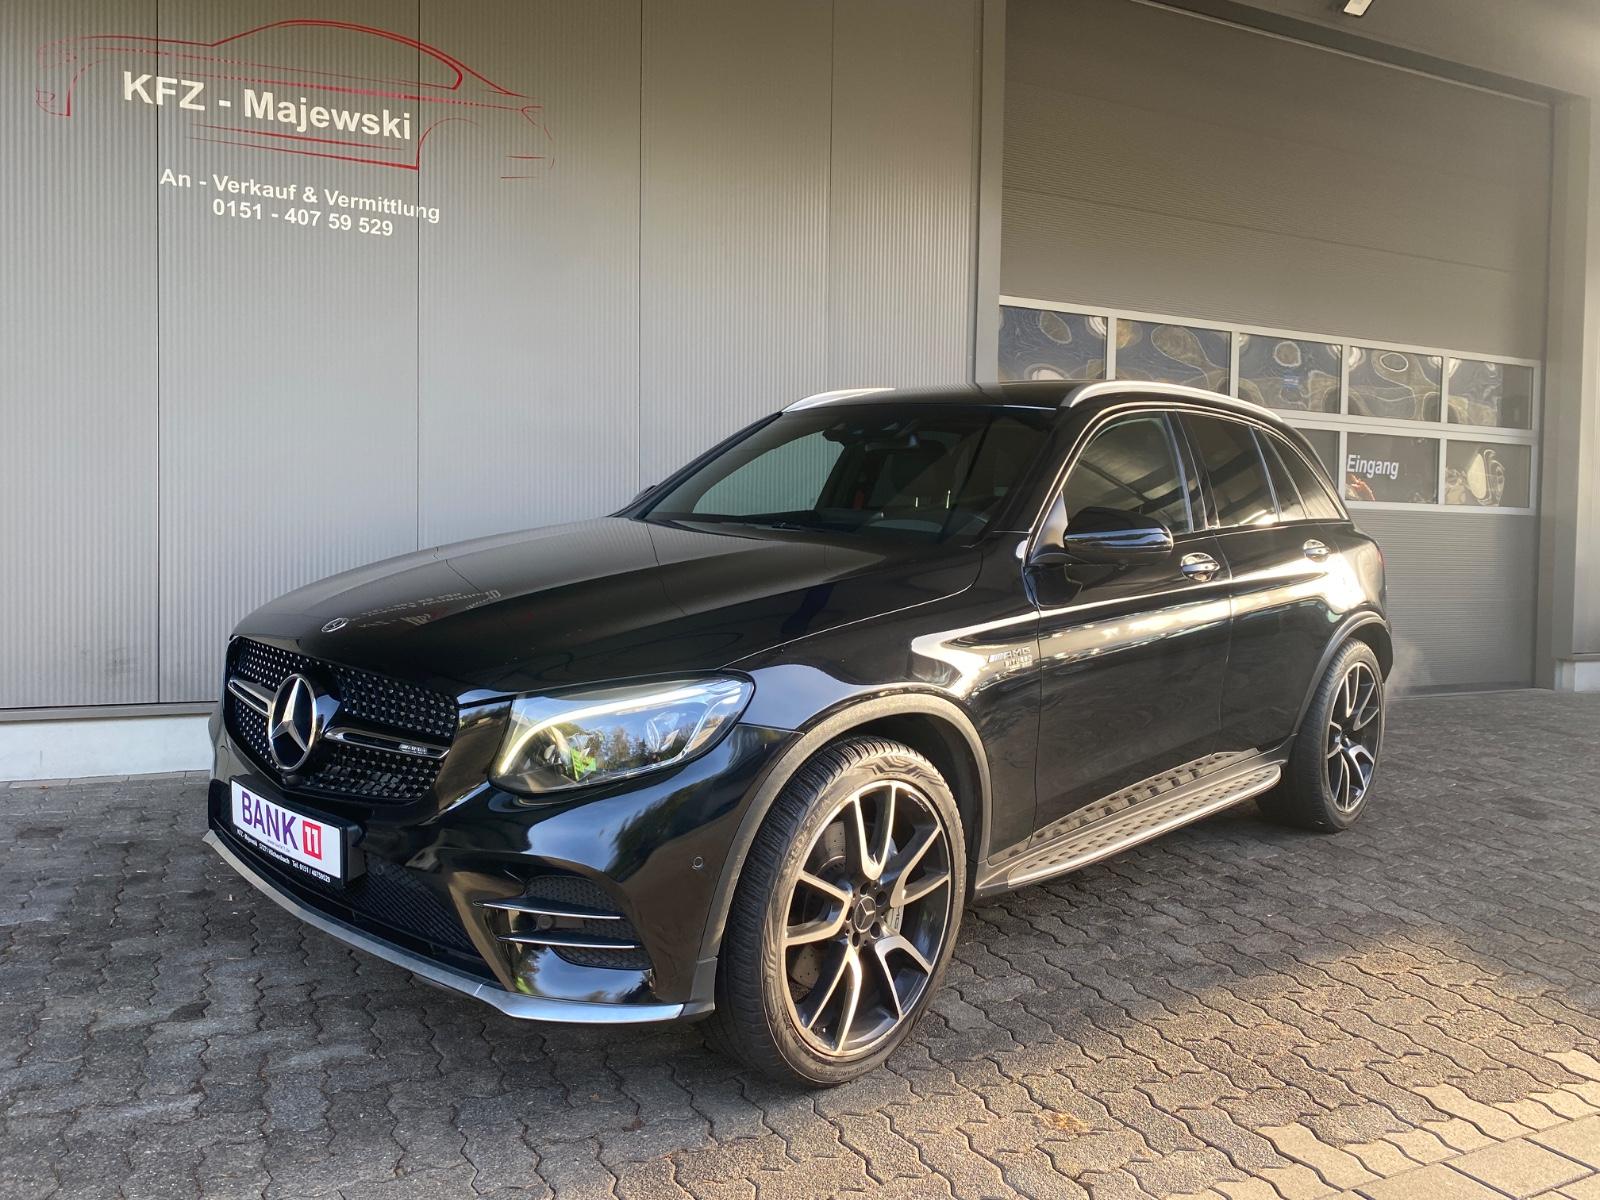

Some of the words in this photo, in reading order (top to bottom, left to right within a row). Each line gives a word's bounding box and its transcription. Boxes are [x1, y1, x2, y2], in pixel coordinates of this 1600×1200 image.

[123, 71, 206, 111] KFZ
[218, 99, 232, 108] -
[244, 88, 411, 140] Majewski
[159, 168, 192, 191] An
[212, 173, 298, 202] Verkauf
[302, 185, 319, 205] &
[323, 188, 440, 225] Vermittlung
[212, 198, 264, 221] 0151
[283, 207, 322, 227] 407
[327, 212, 352, 231] 59
[358, 216, 394, 237] 529
[1346, 454, 1399, 479] Eingang
[242, 790, 299, 850] BANK
[304, 825, 320, 856] 11
